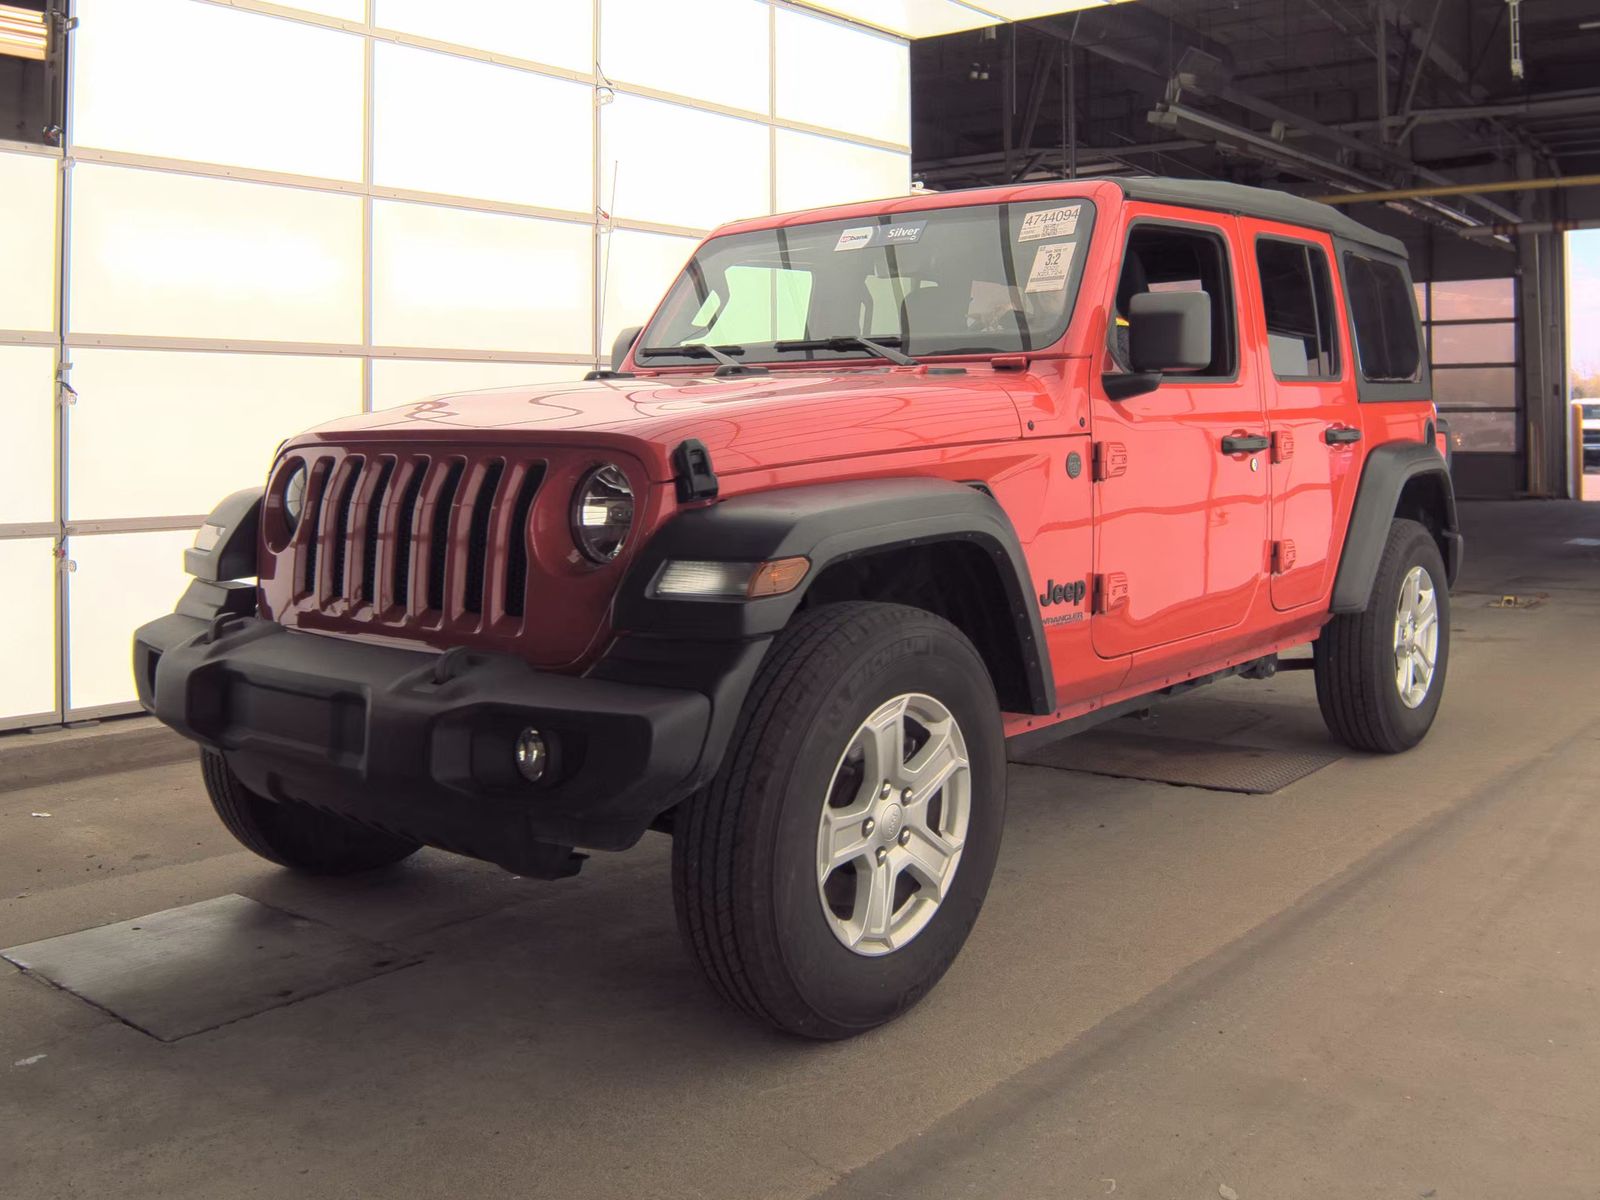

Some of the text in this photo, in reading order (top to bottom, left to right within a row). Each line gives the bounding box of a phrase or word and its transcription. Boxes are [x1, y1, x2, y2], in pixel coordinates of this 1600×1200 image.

[1025, 208, 1079, 226] 4744094
[887, 227, 920, 238] Silver
[1039, 579, 1086, 607] Jeep
